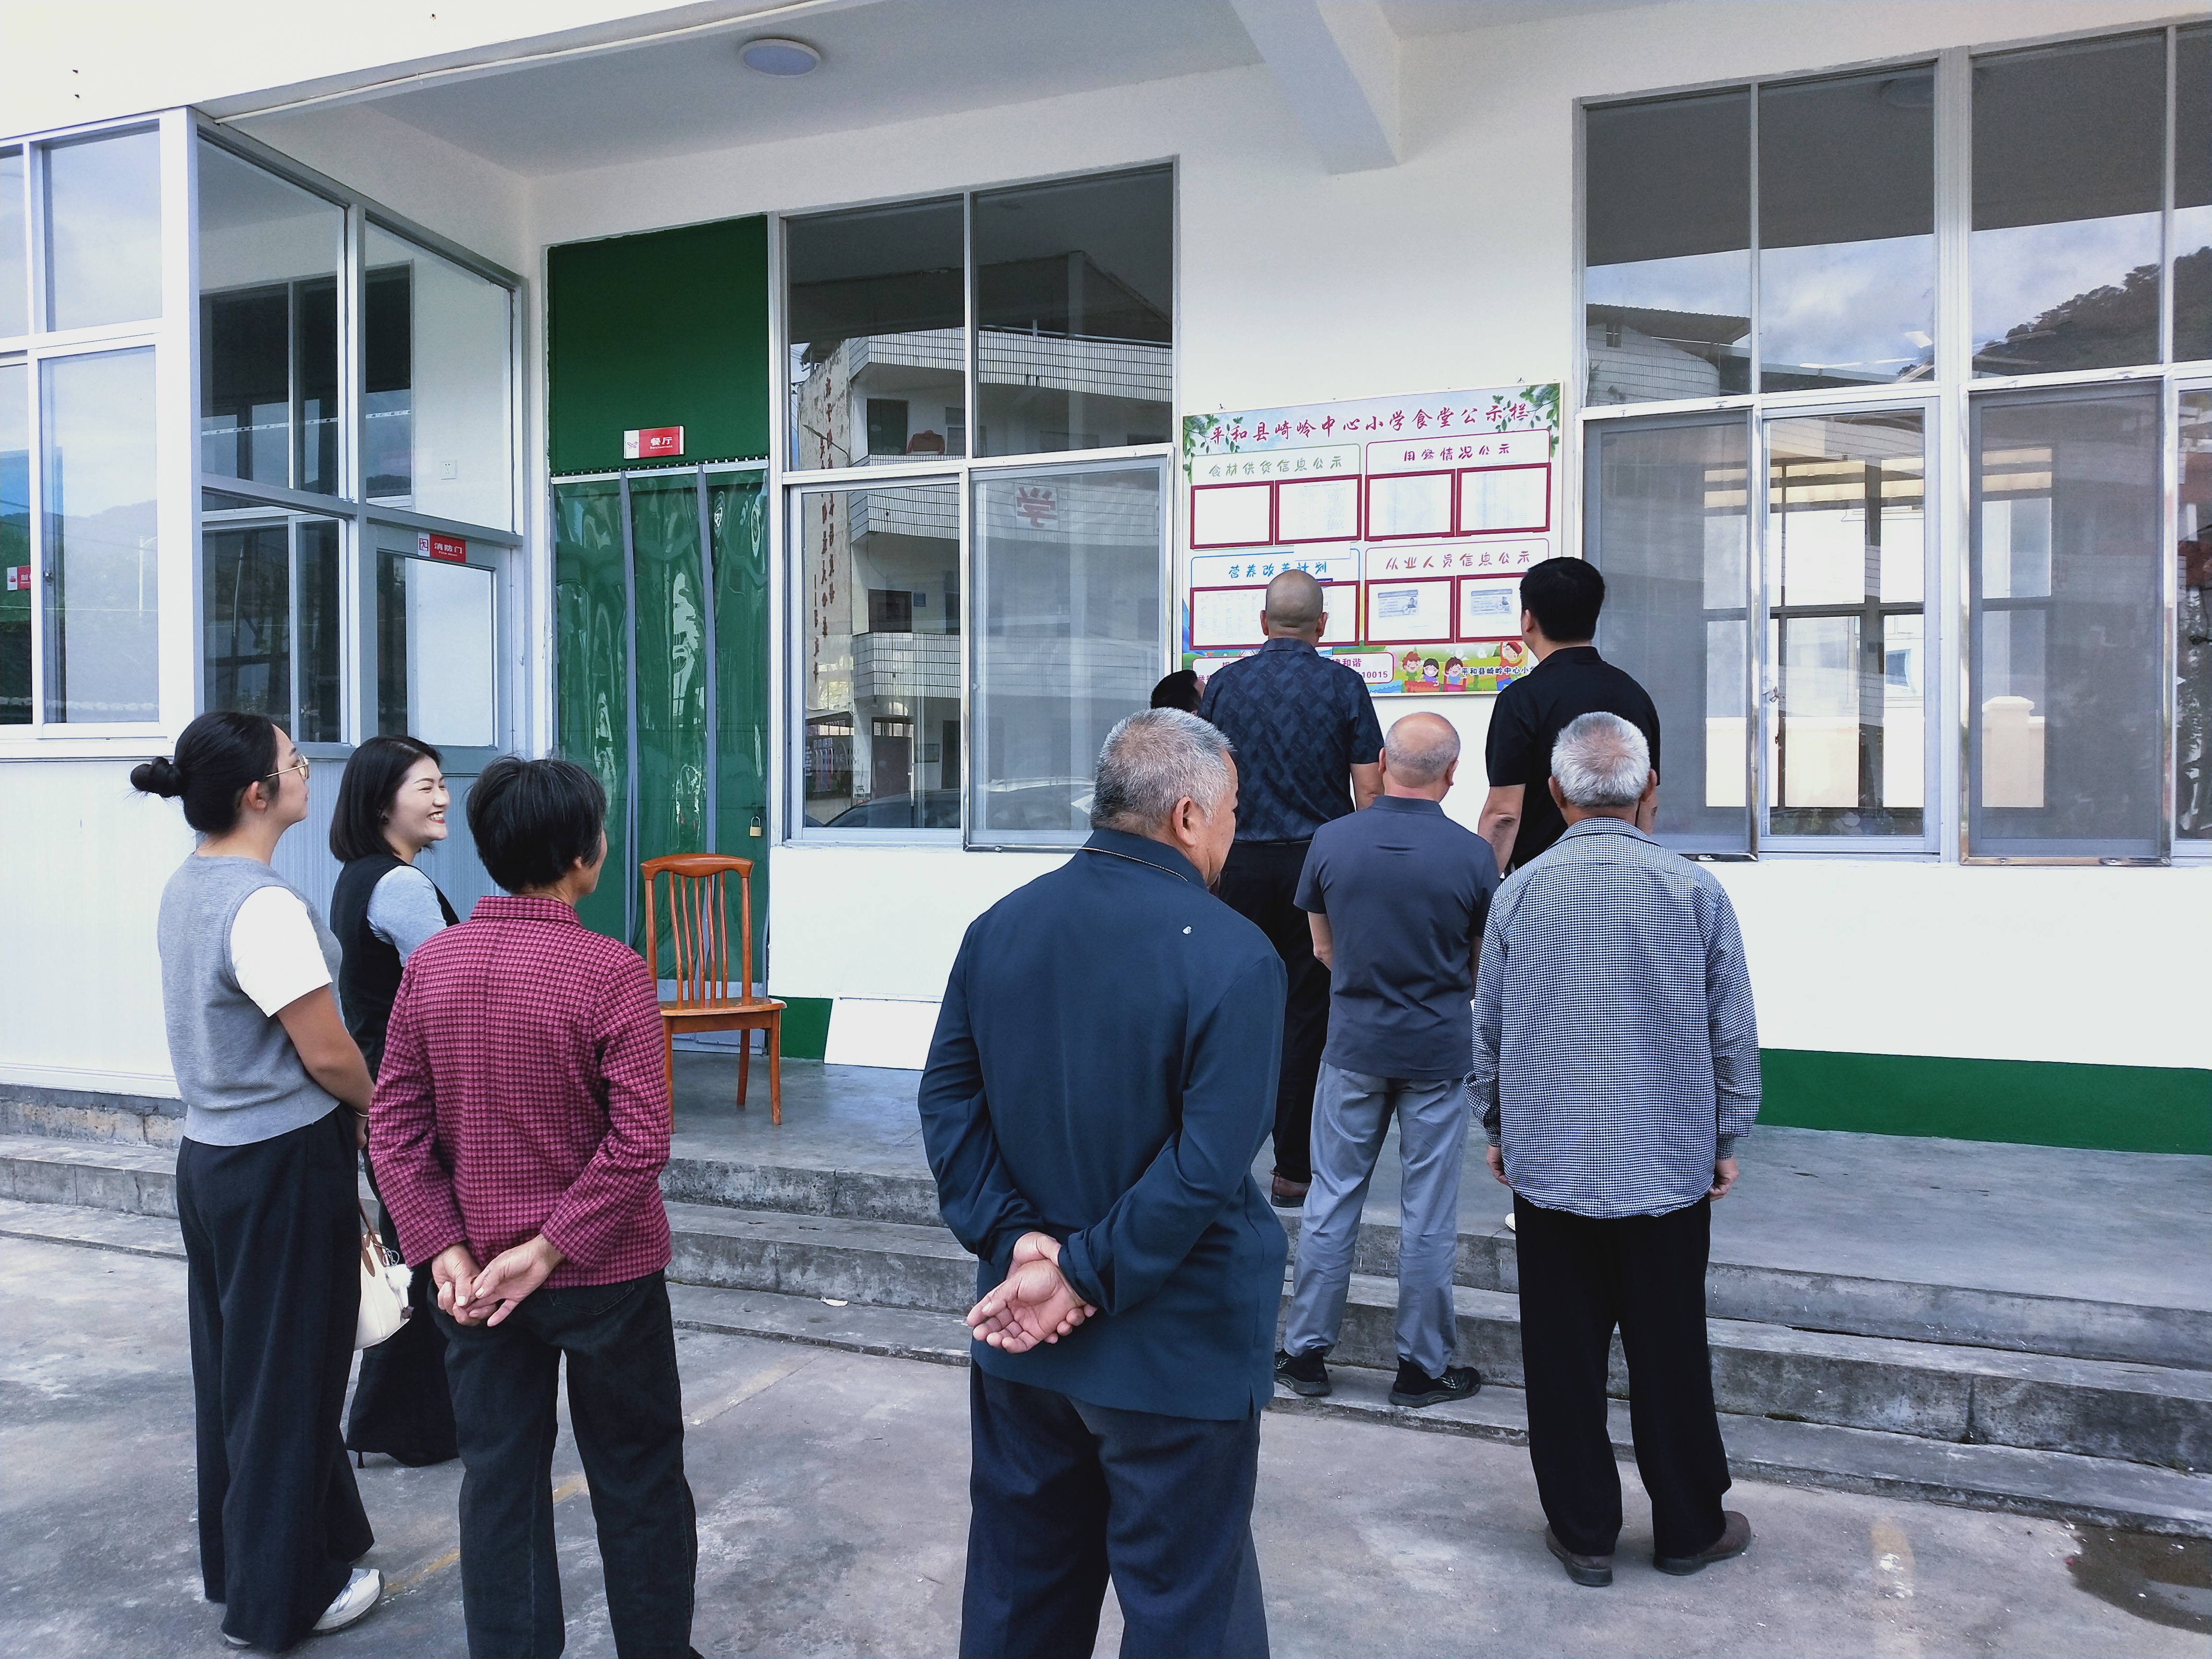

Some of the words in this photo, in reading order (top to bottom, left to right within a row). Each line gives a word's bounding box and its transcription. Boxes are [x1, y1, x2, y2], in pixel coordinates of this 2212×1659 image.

[1210, 403, 1529, 445] 平和县崎岭中心小学食堂公示栏
[650, 436, 673, 446] 餐厅
[1404, 444, 1510, 462] 用餐情况公示
[1209, 456, 1342, 477] 食材供货信息公示
[434, 542, 462, 554] 消防门
[1386, 551, 1530, 570] 从业人员信息公示
